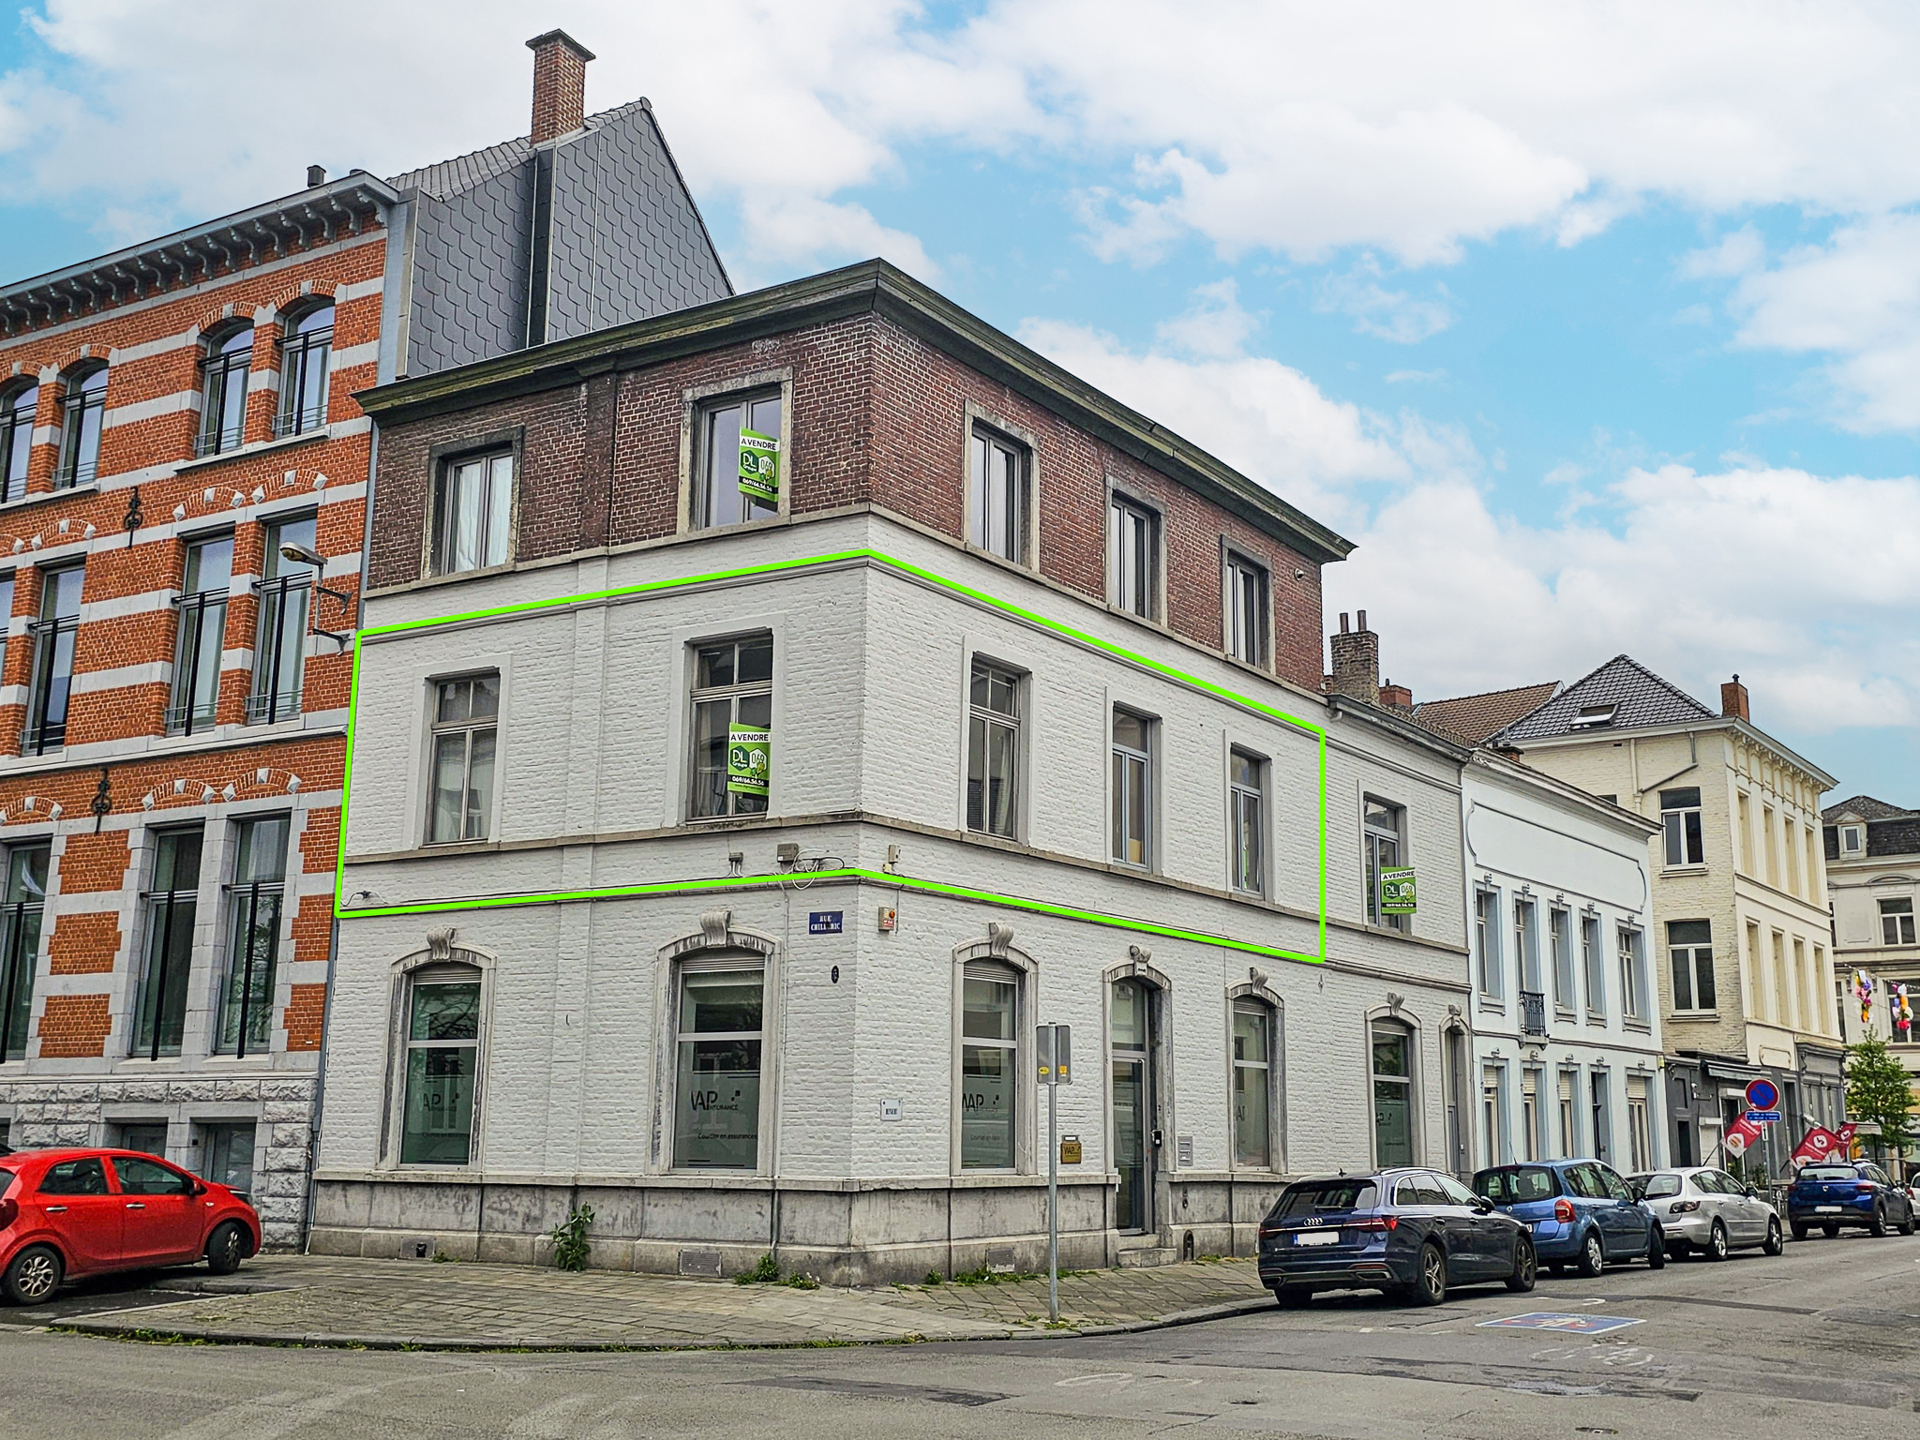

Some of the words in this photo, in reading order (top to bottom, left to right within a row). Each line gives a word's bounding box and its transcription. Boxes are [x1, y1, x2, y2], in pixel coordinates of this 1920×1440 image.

[741, 438, 747, 446] A
[747, 439, 777, 451] VENDRE
[743, 453, 757, 468] DL
[738, 734, 769, 742] VENDRE
[732, 749, 748, 763] DL
[1388, 871, 1415, 879] VENDRE
[819, 915, 832, 923] RUE
[810, 922, 841, 931] CHILRIC
